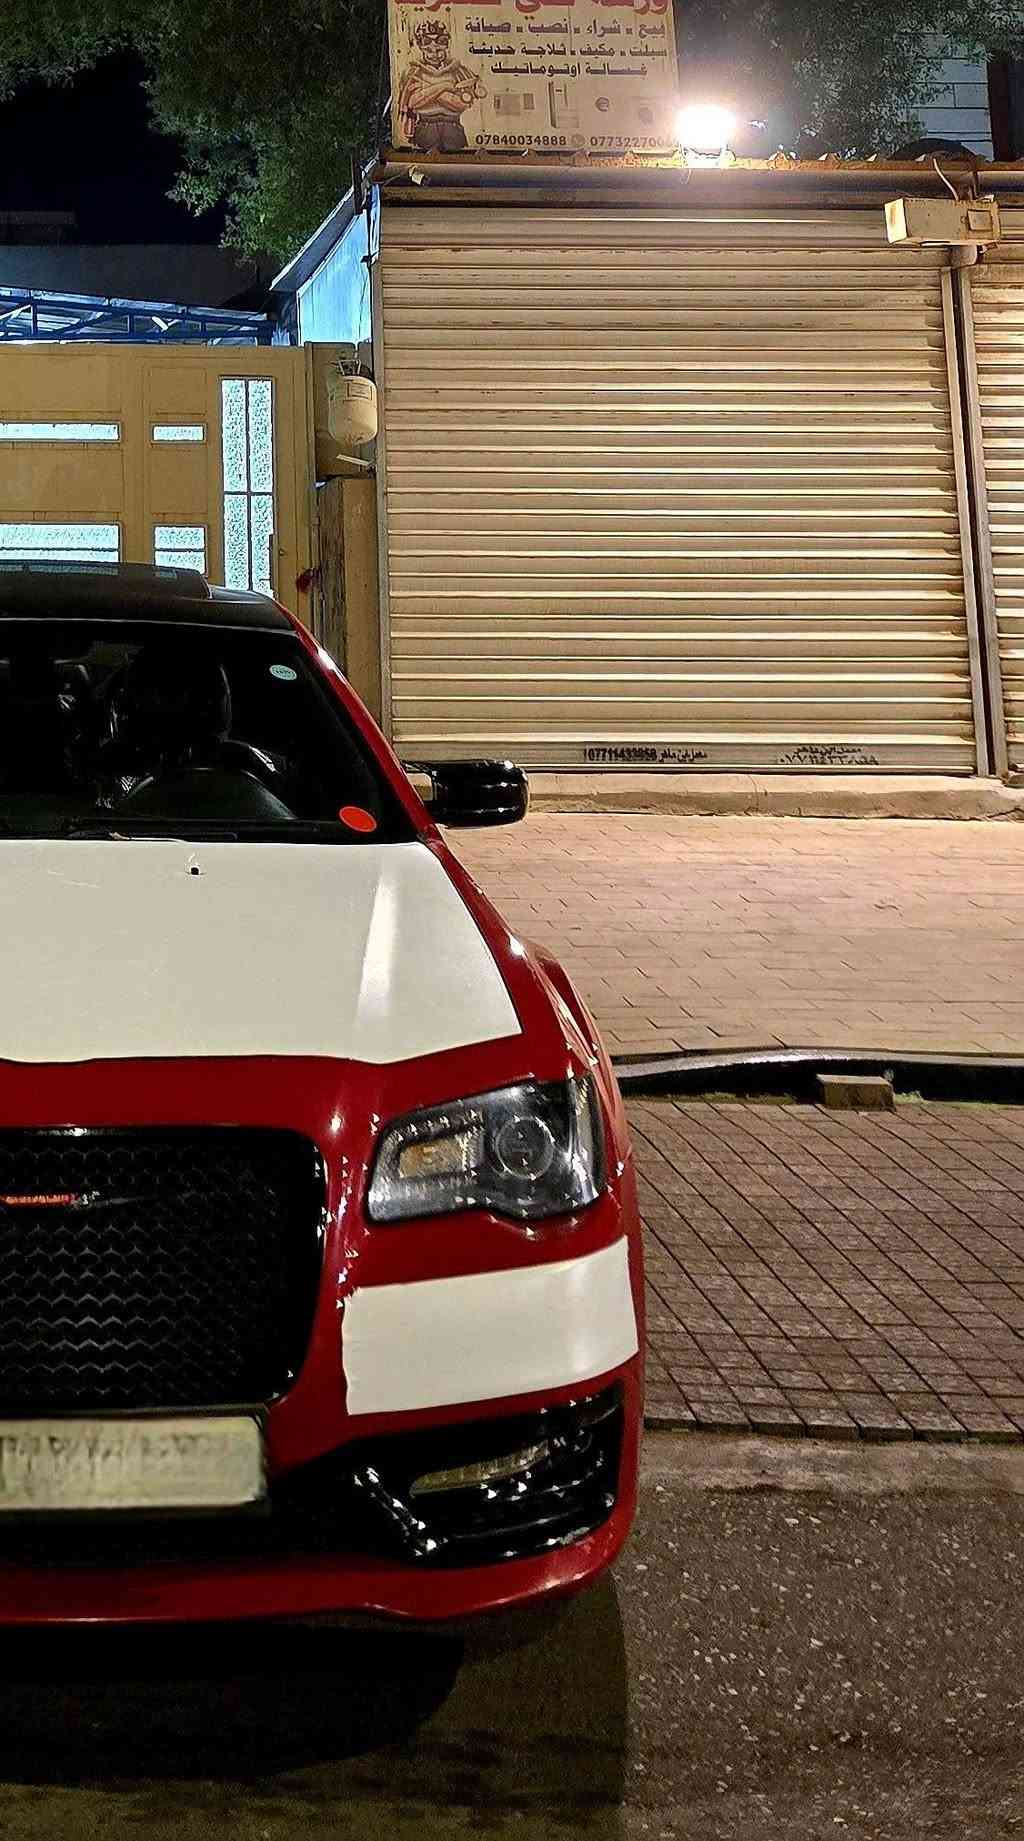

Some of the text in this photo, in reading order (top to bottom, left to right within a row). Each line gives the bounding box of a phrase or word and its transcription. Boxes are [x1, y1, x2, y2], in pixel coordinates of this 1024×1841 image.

[465, 16, 511, 37] صيانة
[527, 18, 569, 37] نصب
[586, 19, 621, 38] شراء
[638, 24, 665, 39] بيع
[468, 41, 516, 57] حديثة
[520, 42, 566, 58] ثلاجة
[579, 43, 616, 59] مكيف
[629, 44, 667, 60] سبلت
[585, 62, 647, 76] غسالة
[475, 134, 567, 146] 07840034888
